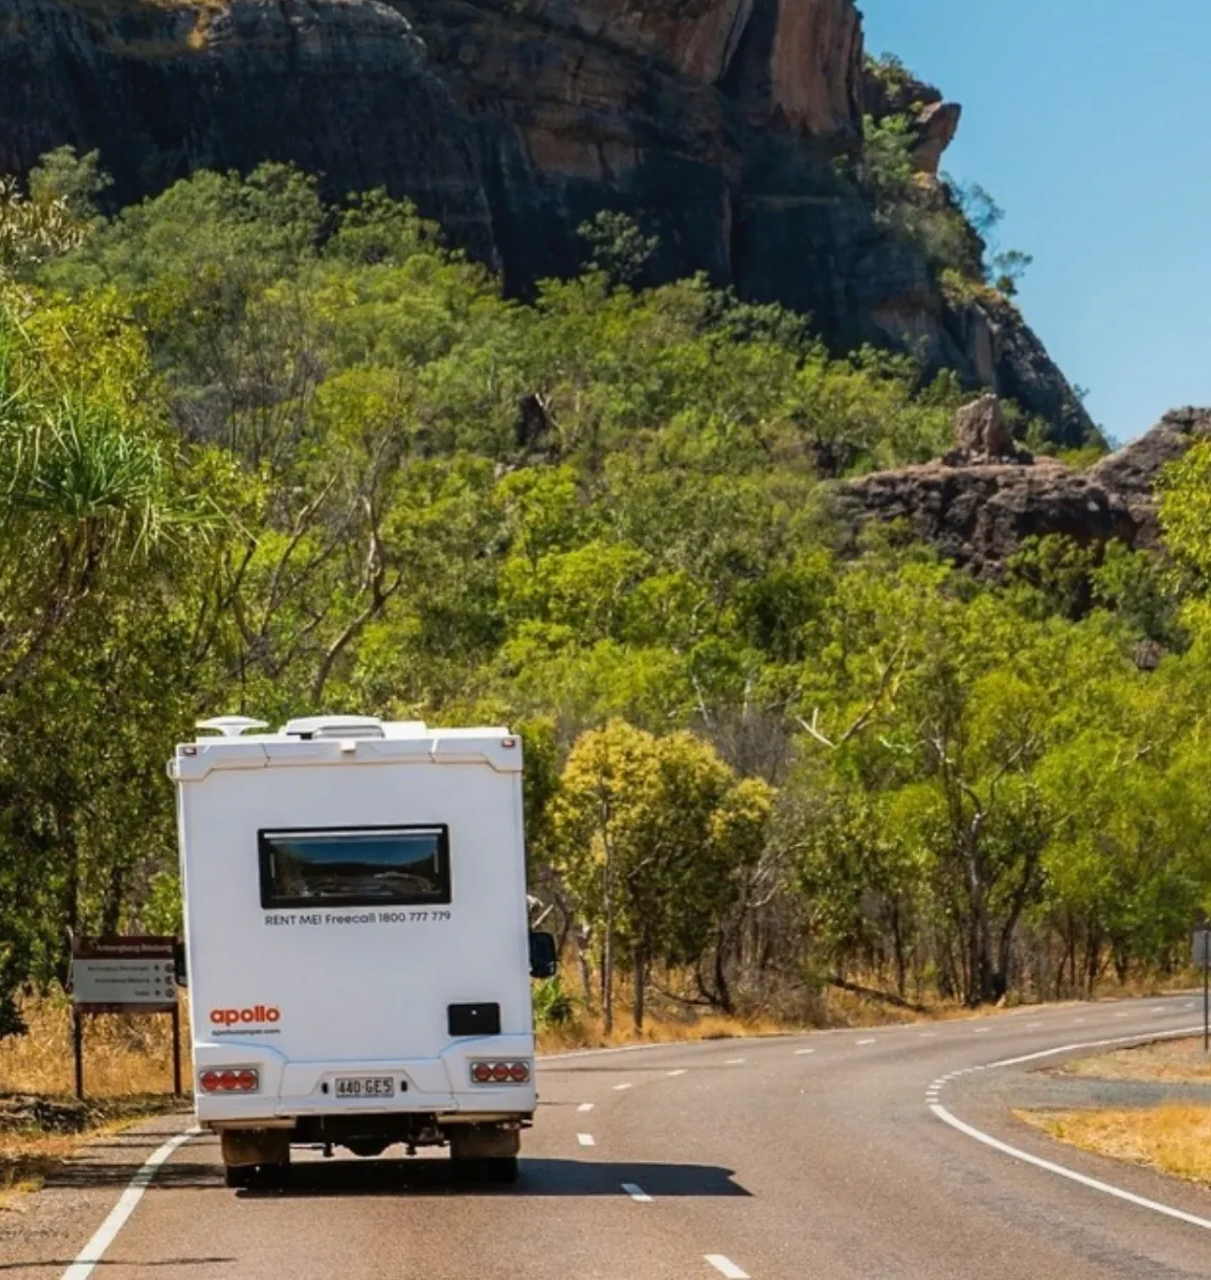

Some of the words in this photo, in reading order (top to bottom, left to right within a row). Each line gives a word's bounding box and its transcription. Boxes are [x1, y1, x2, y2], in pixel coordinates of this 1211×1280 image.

[265, 914, 295, 925] RENT
[299, 914, 322, 925] ME!
[325, 912, 376, 924] Freecall
[378, 912, 406, 923] 1800
[409, 911, 428, 922] 777
[431, 910, 451, 921] 779
[210, 1006, 280, 1026] apollo
